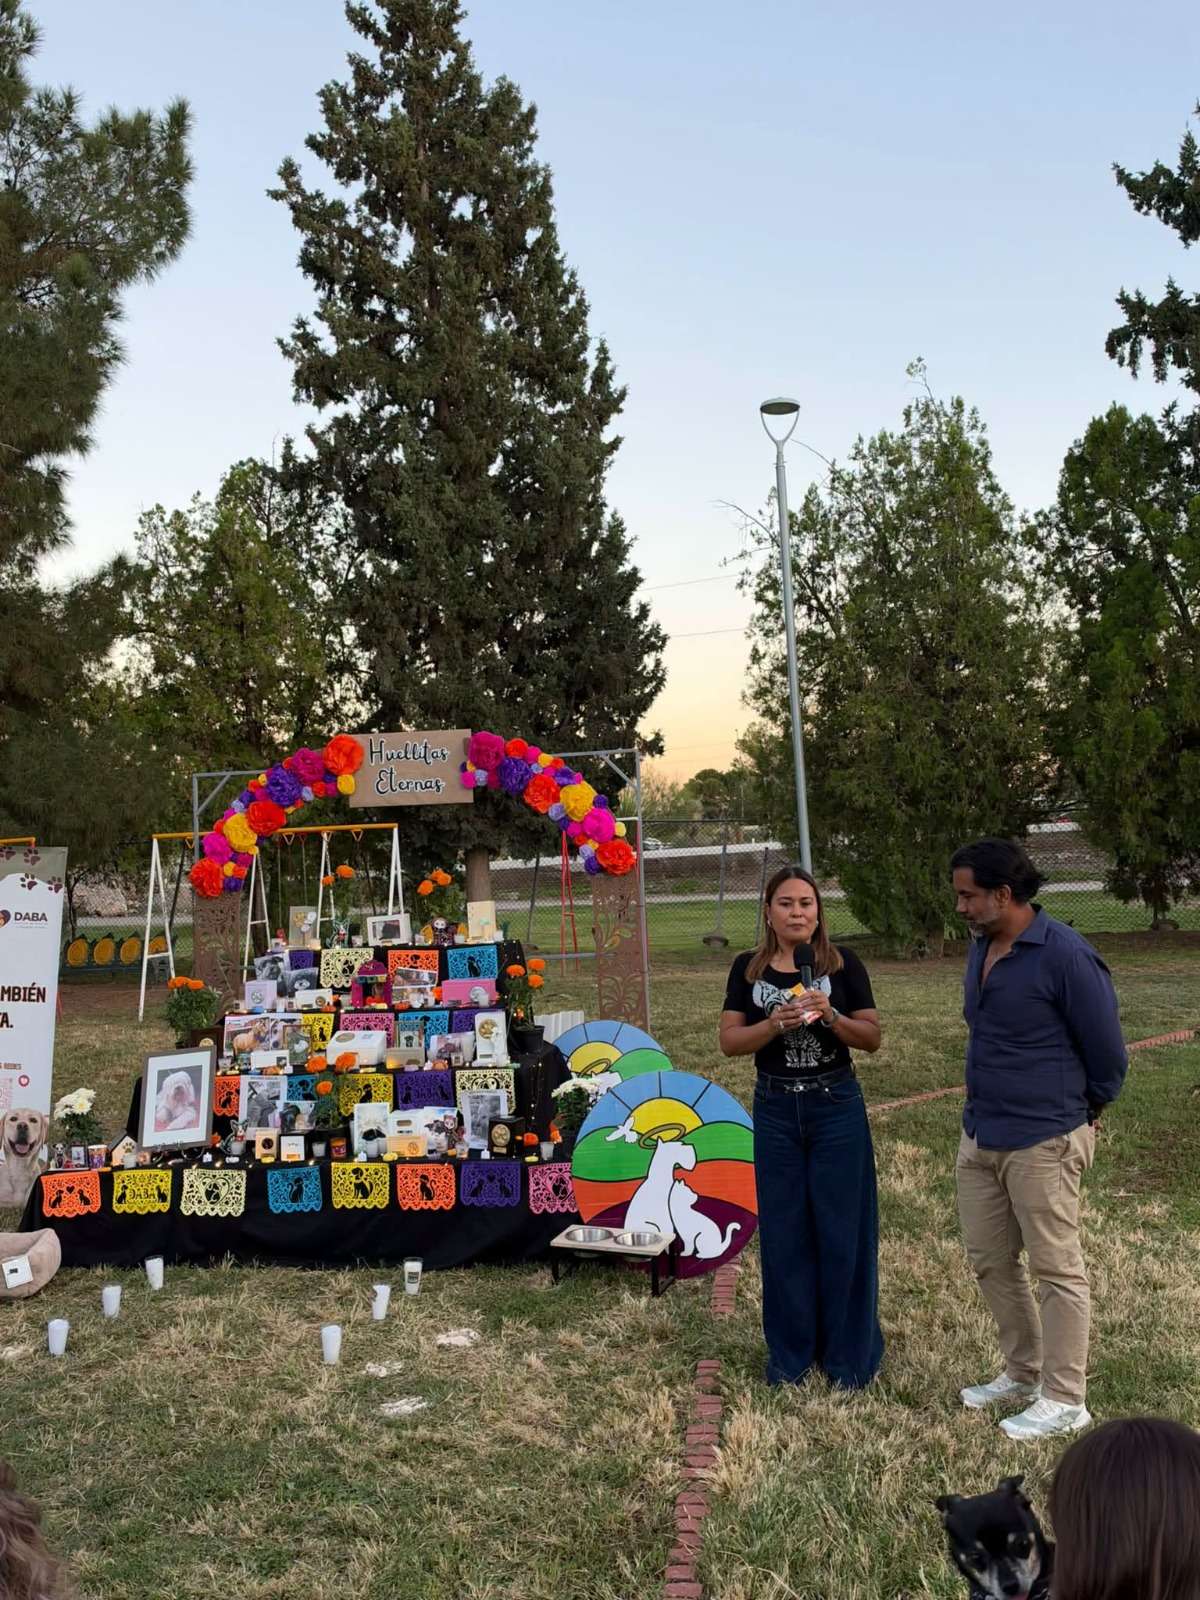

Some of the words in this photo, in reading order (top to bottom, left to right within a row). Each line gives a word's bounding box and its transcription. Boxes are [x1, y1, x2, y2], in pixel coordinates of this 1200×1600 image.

[368, 738, 448, 765] Huellitas
[375, 766, 443, 795] Eternas
[14, 911, 48, 922] DABA
[0, 981, 46, 1003] MBIÉN
[0, 1012, 14, 1028] A.
